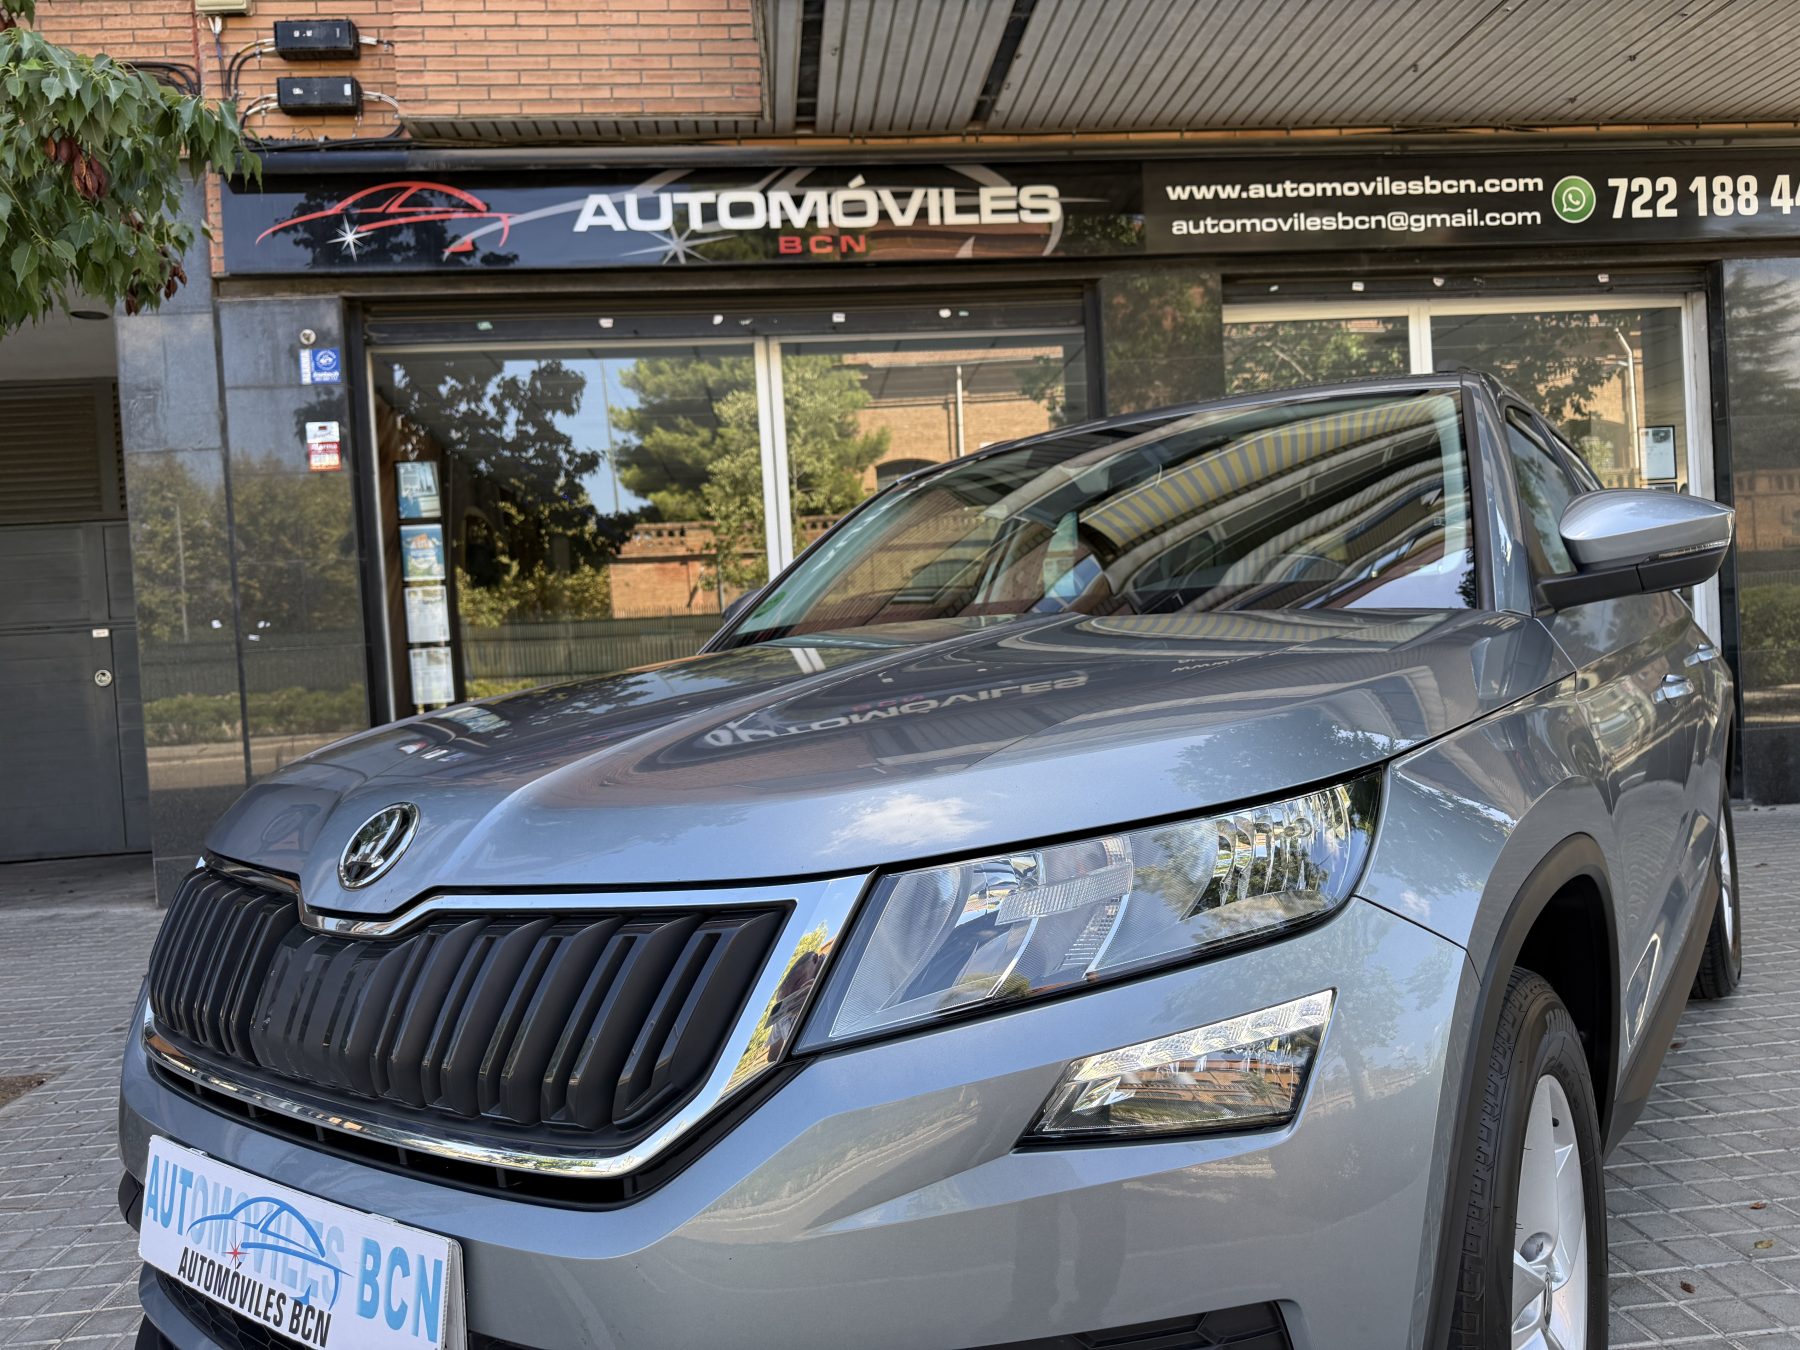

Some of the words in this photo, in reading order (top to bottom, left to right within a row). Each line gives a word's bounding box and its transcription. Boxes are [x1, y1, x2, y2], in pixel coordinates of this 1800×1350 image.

[573, 174, 1061, 233] AUTOMÓVILES
[1166, 175, 1544, 201] www.automovilesbcn.com
[1607, 176, 1678, 219] 722
[1688, 174, 1759, 217] 188
[1770, 174, 1800, 215] 4
[1171, 208, 1542, 235] automovilesbcn@gmail.com
[778, 235, 866, 254] BCN
[177, 1246, 287, 1328] AUTOMÓVILES
[289, 1300, 332, 1349] BCN
[356, 1237, 443, 1344] BCN
